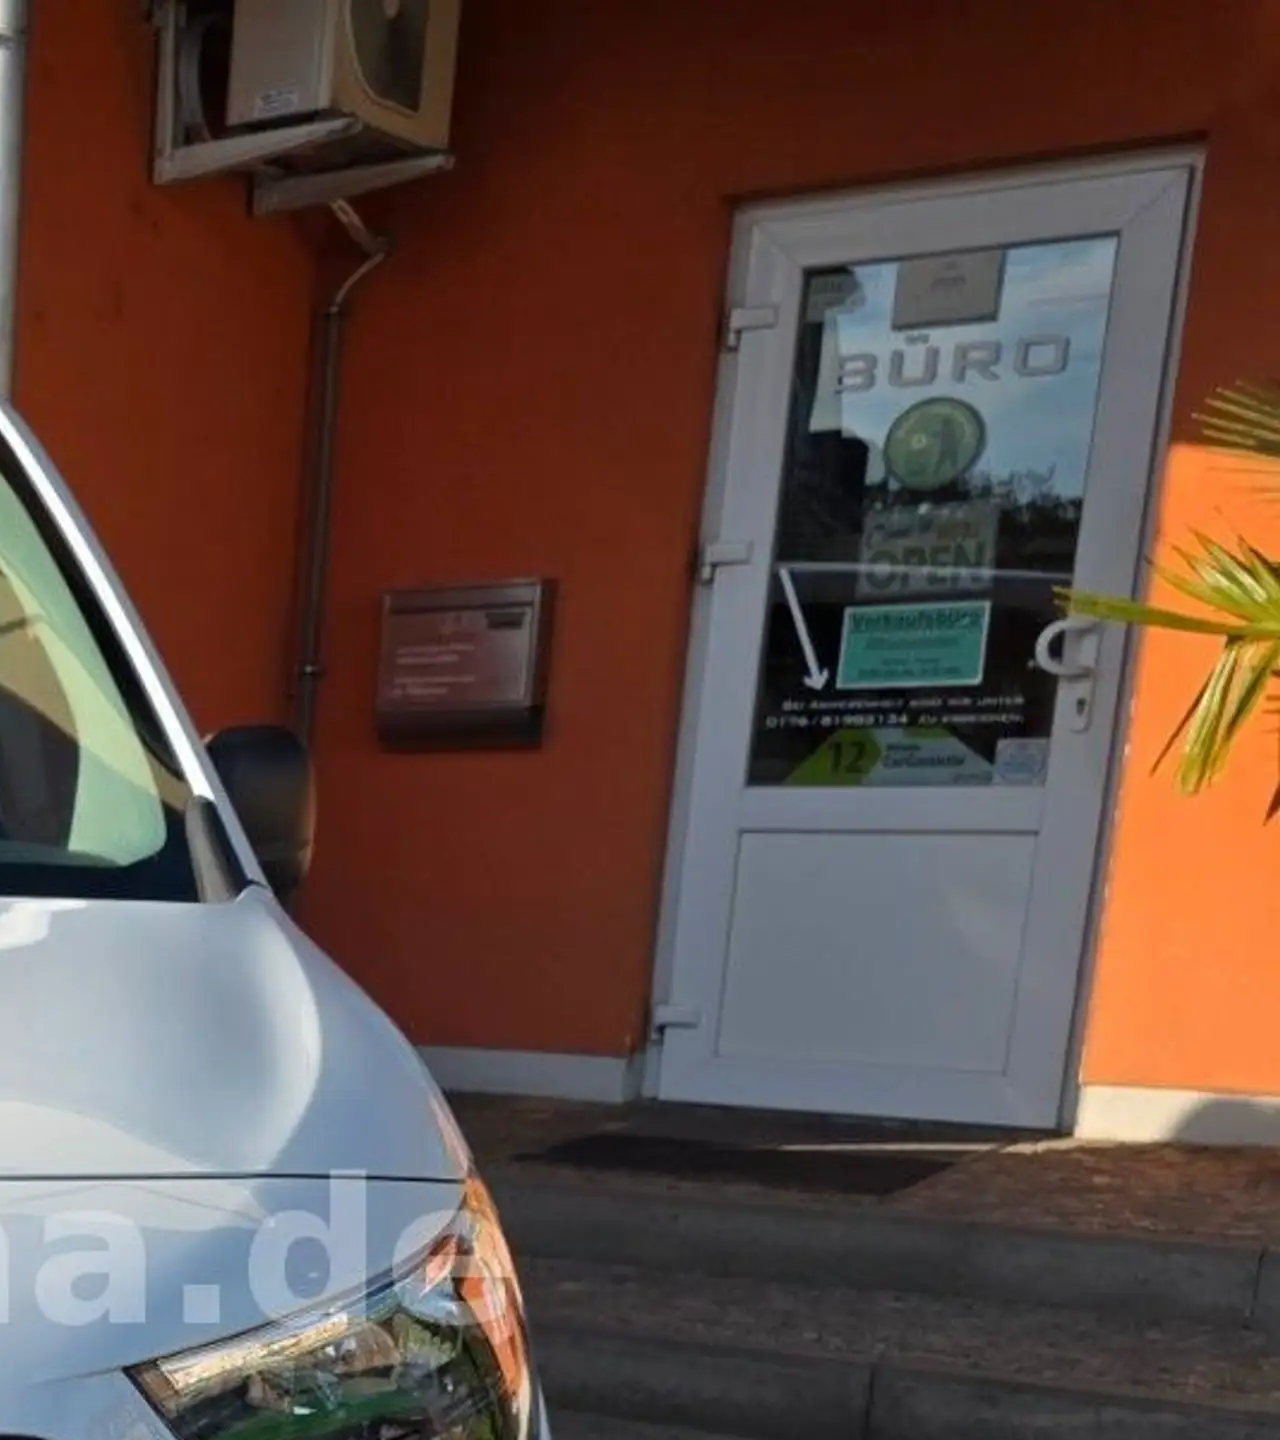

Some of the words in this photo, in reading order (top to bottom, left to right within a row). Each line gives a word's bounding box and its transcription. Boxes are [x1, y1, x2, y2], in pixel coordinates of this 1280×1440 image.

[834, 333, 1070, 395] BÜRO
[865, 540, 988, 591] OPEN
[828, 740, 866, 774] 12
